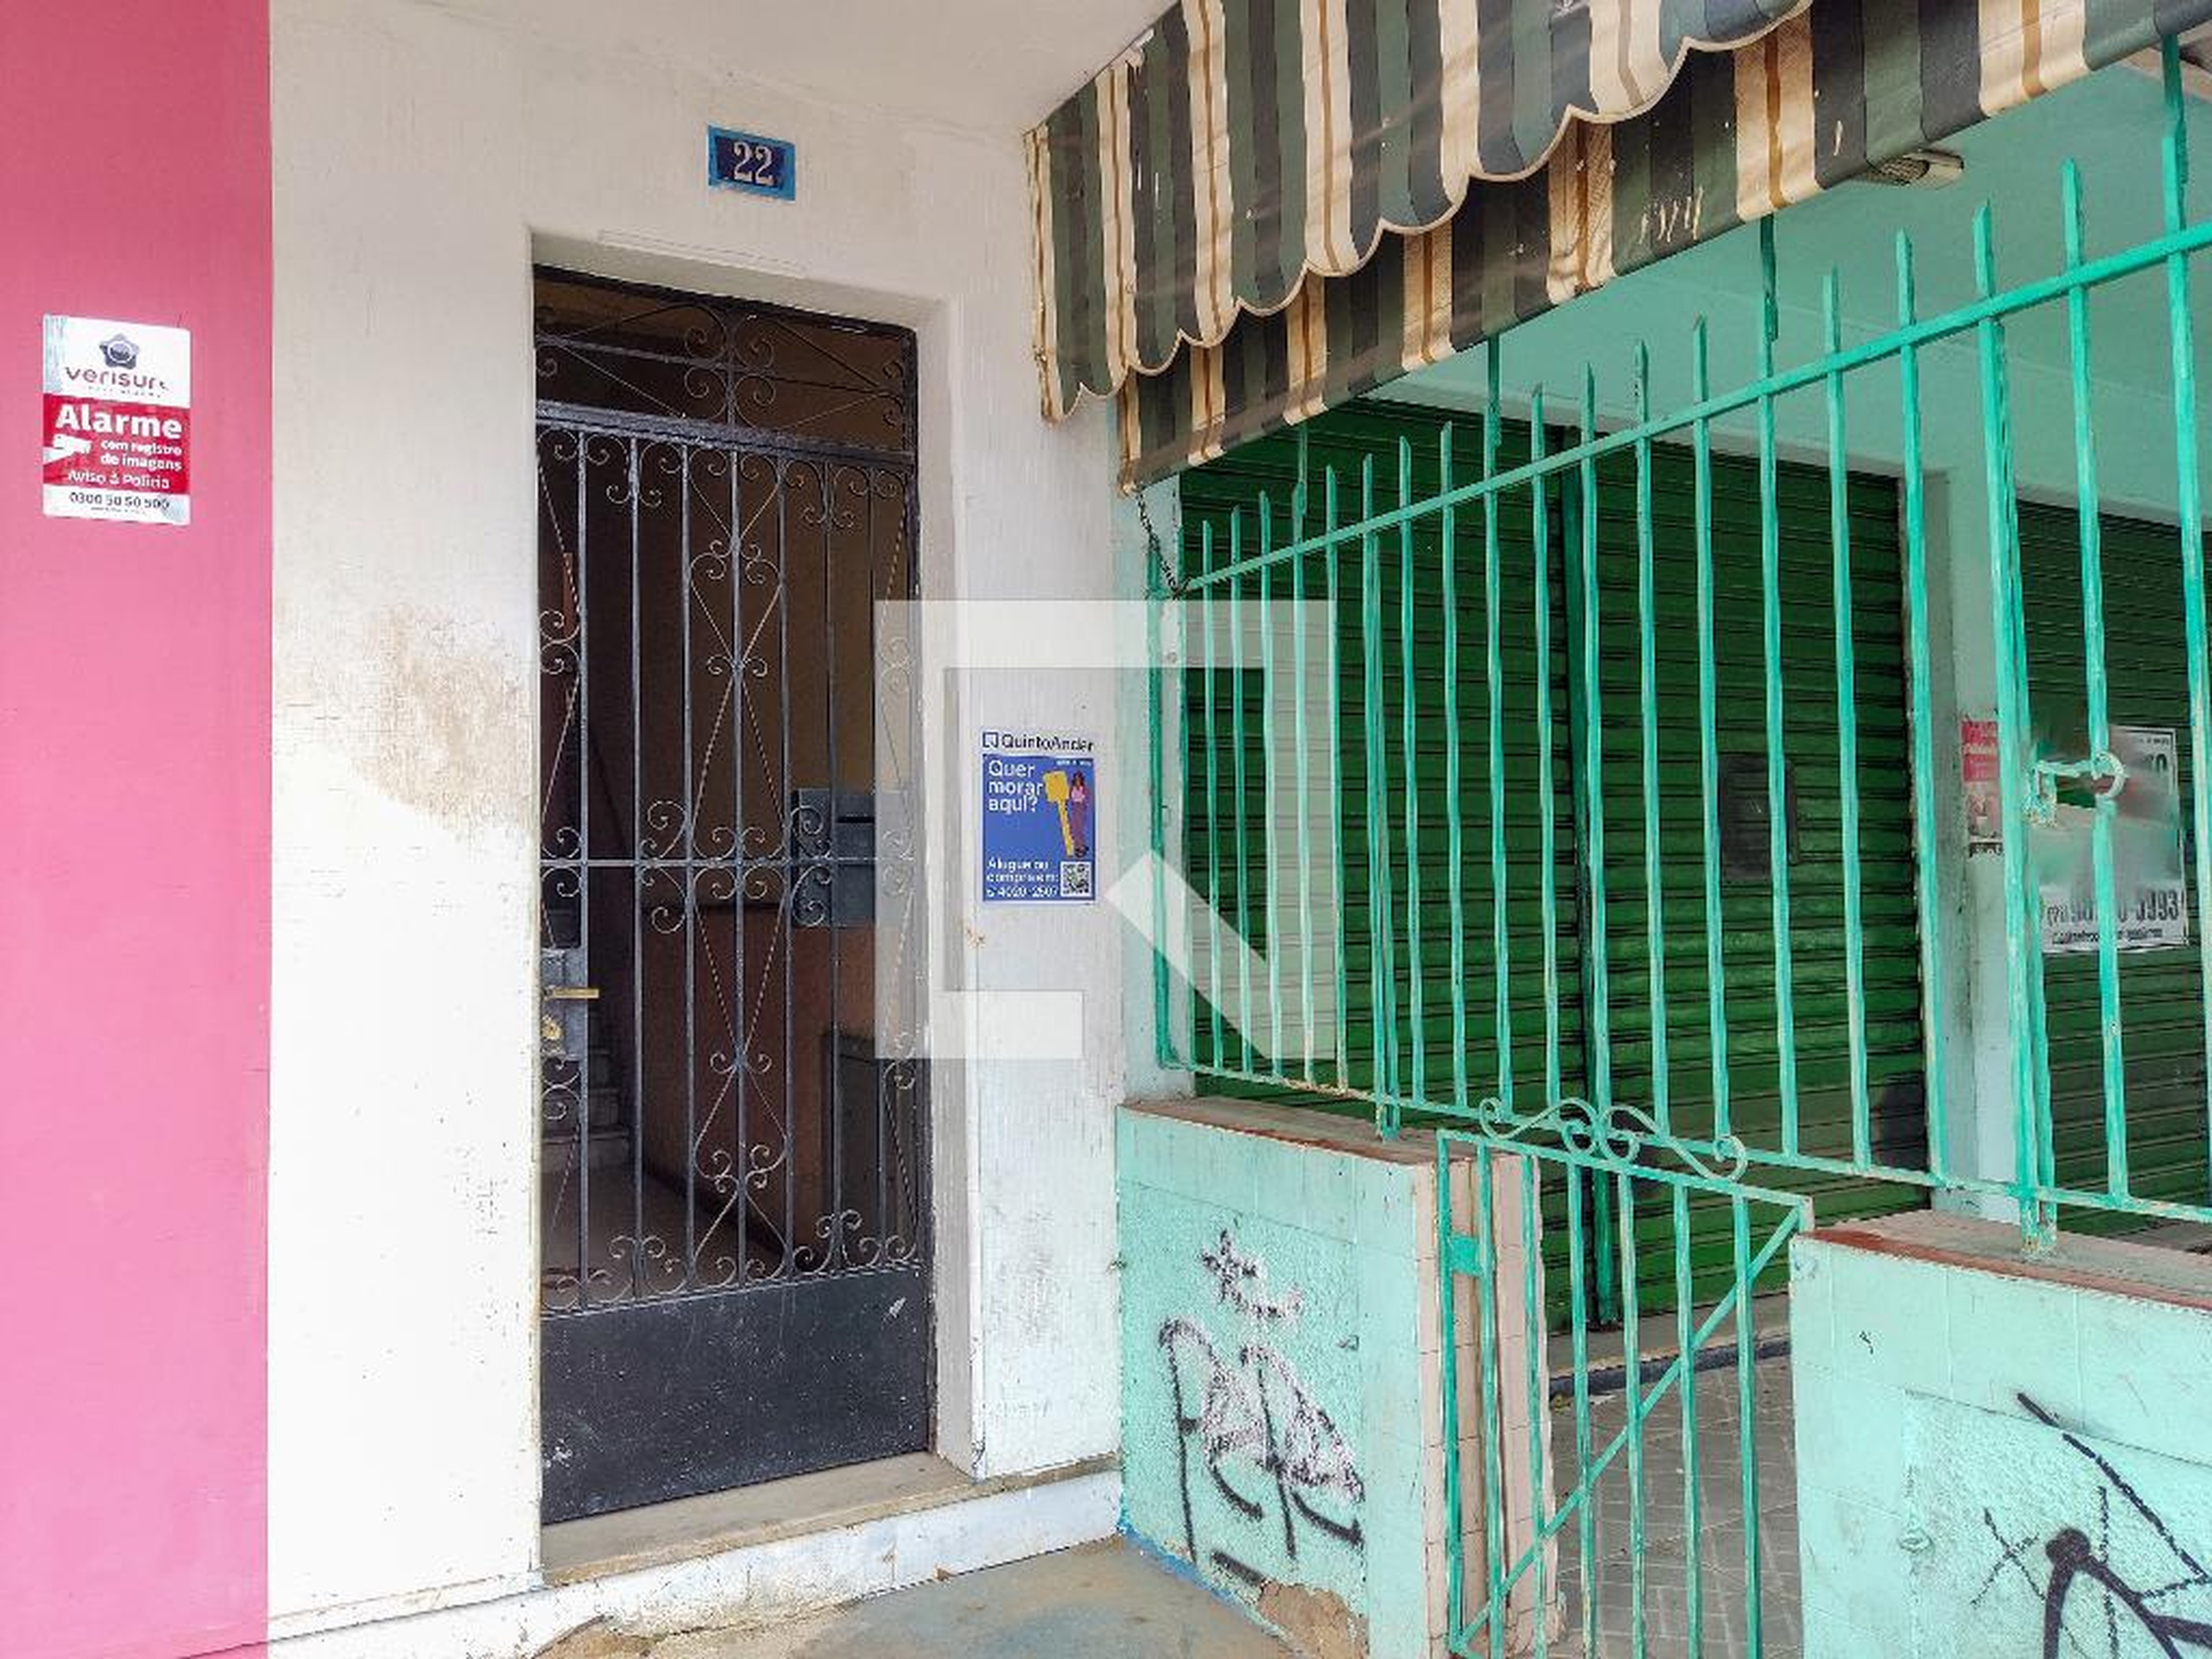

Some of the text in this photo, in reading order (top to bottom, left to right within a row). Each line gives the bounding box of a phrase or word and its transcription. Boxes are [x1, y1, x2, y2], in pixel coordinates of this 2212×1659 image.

[733, 142, 774, 185] 22
[55, 404, 183, 440] Alarme
[101, 440, 183, 456] com registro
[100, 453, 183, 472] de imagens
[1001, 733, 1094, 752] QuintoAndar
[988, 759, 1036, 777] Quer
[988, 781, 1043, 796] morar
[988, 796, 1038, 814] aqui?
